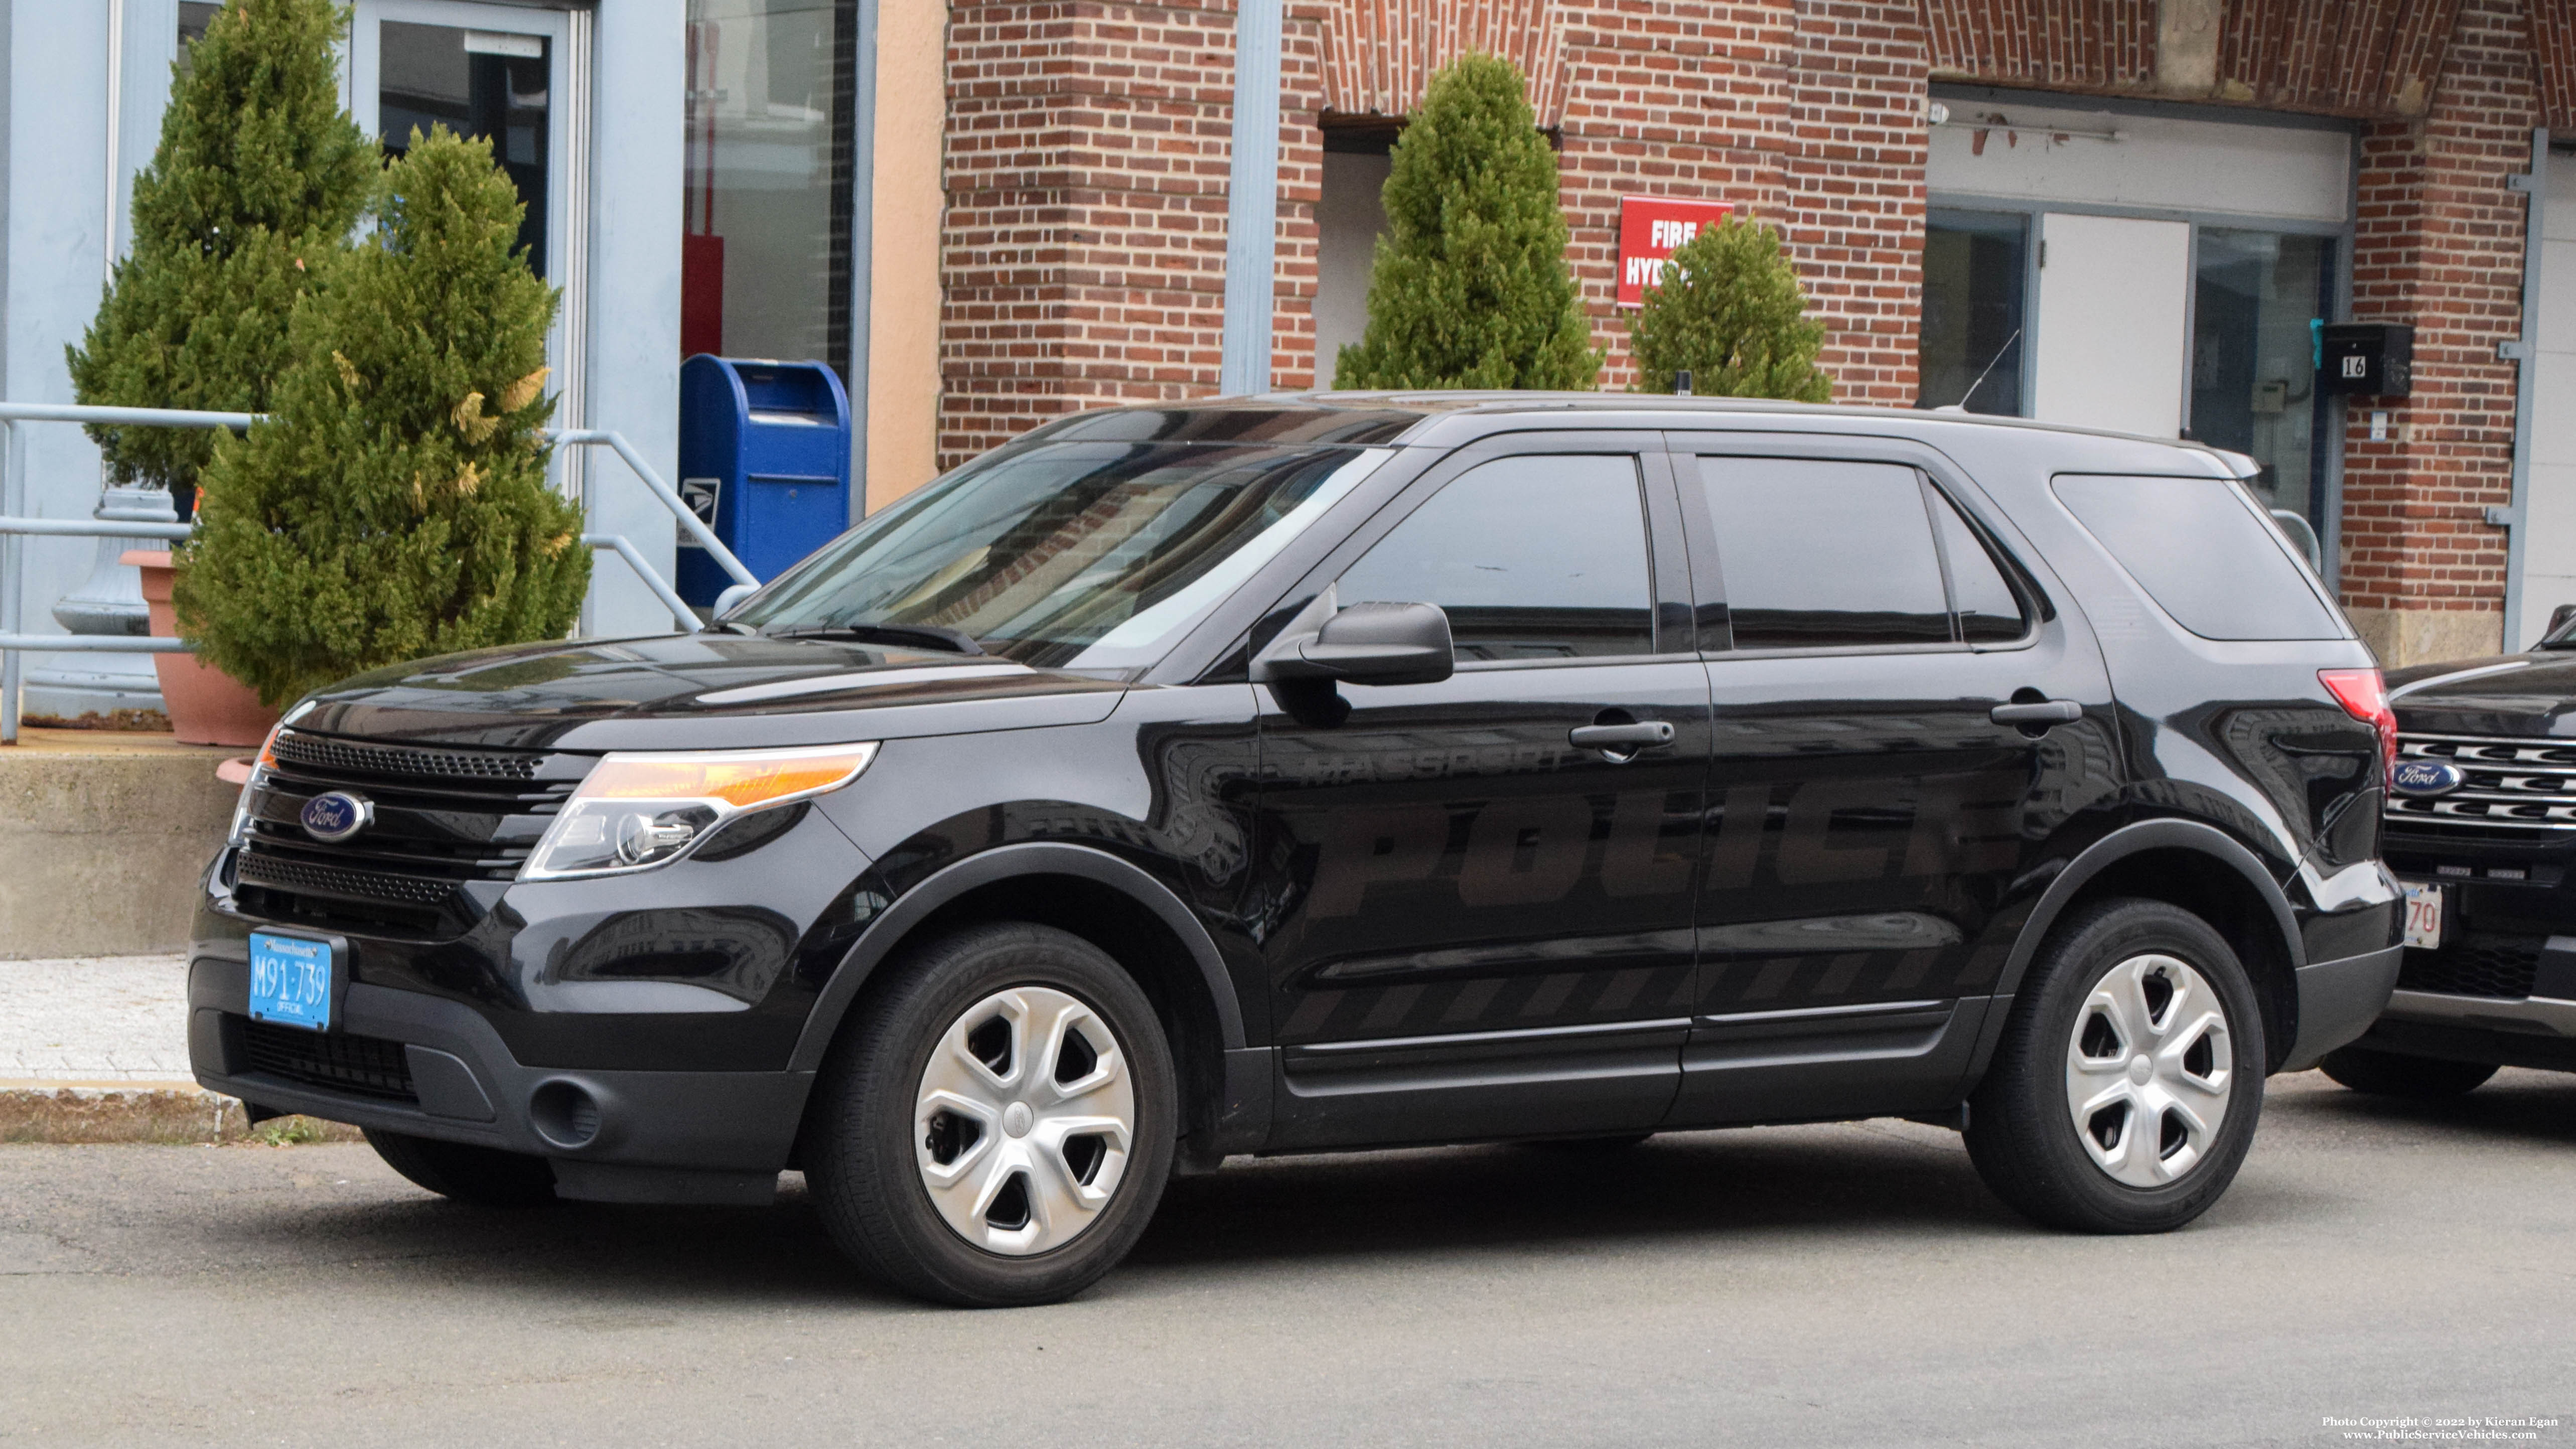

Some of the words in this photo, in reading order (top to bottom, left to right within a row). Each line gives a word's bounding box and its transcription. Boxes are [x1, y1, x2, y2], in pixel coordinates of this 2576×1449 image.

[1651, 219, 1697, 249] FIRE
[2346, 357, 2364, 375] 16
[2398, 765, 2440, 785] Ford
[309, 798, 345, 827] Ford
[1305, 771, 2022, 921] POLICE
[269, 938, 314, 958] Massachusetts
[277, 1000, 304, 1016] OFFICIAL
